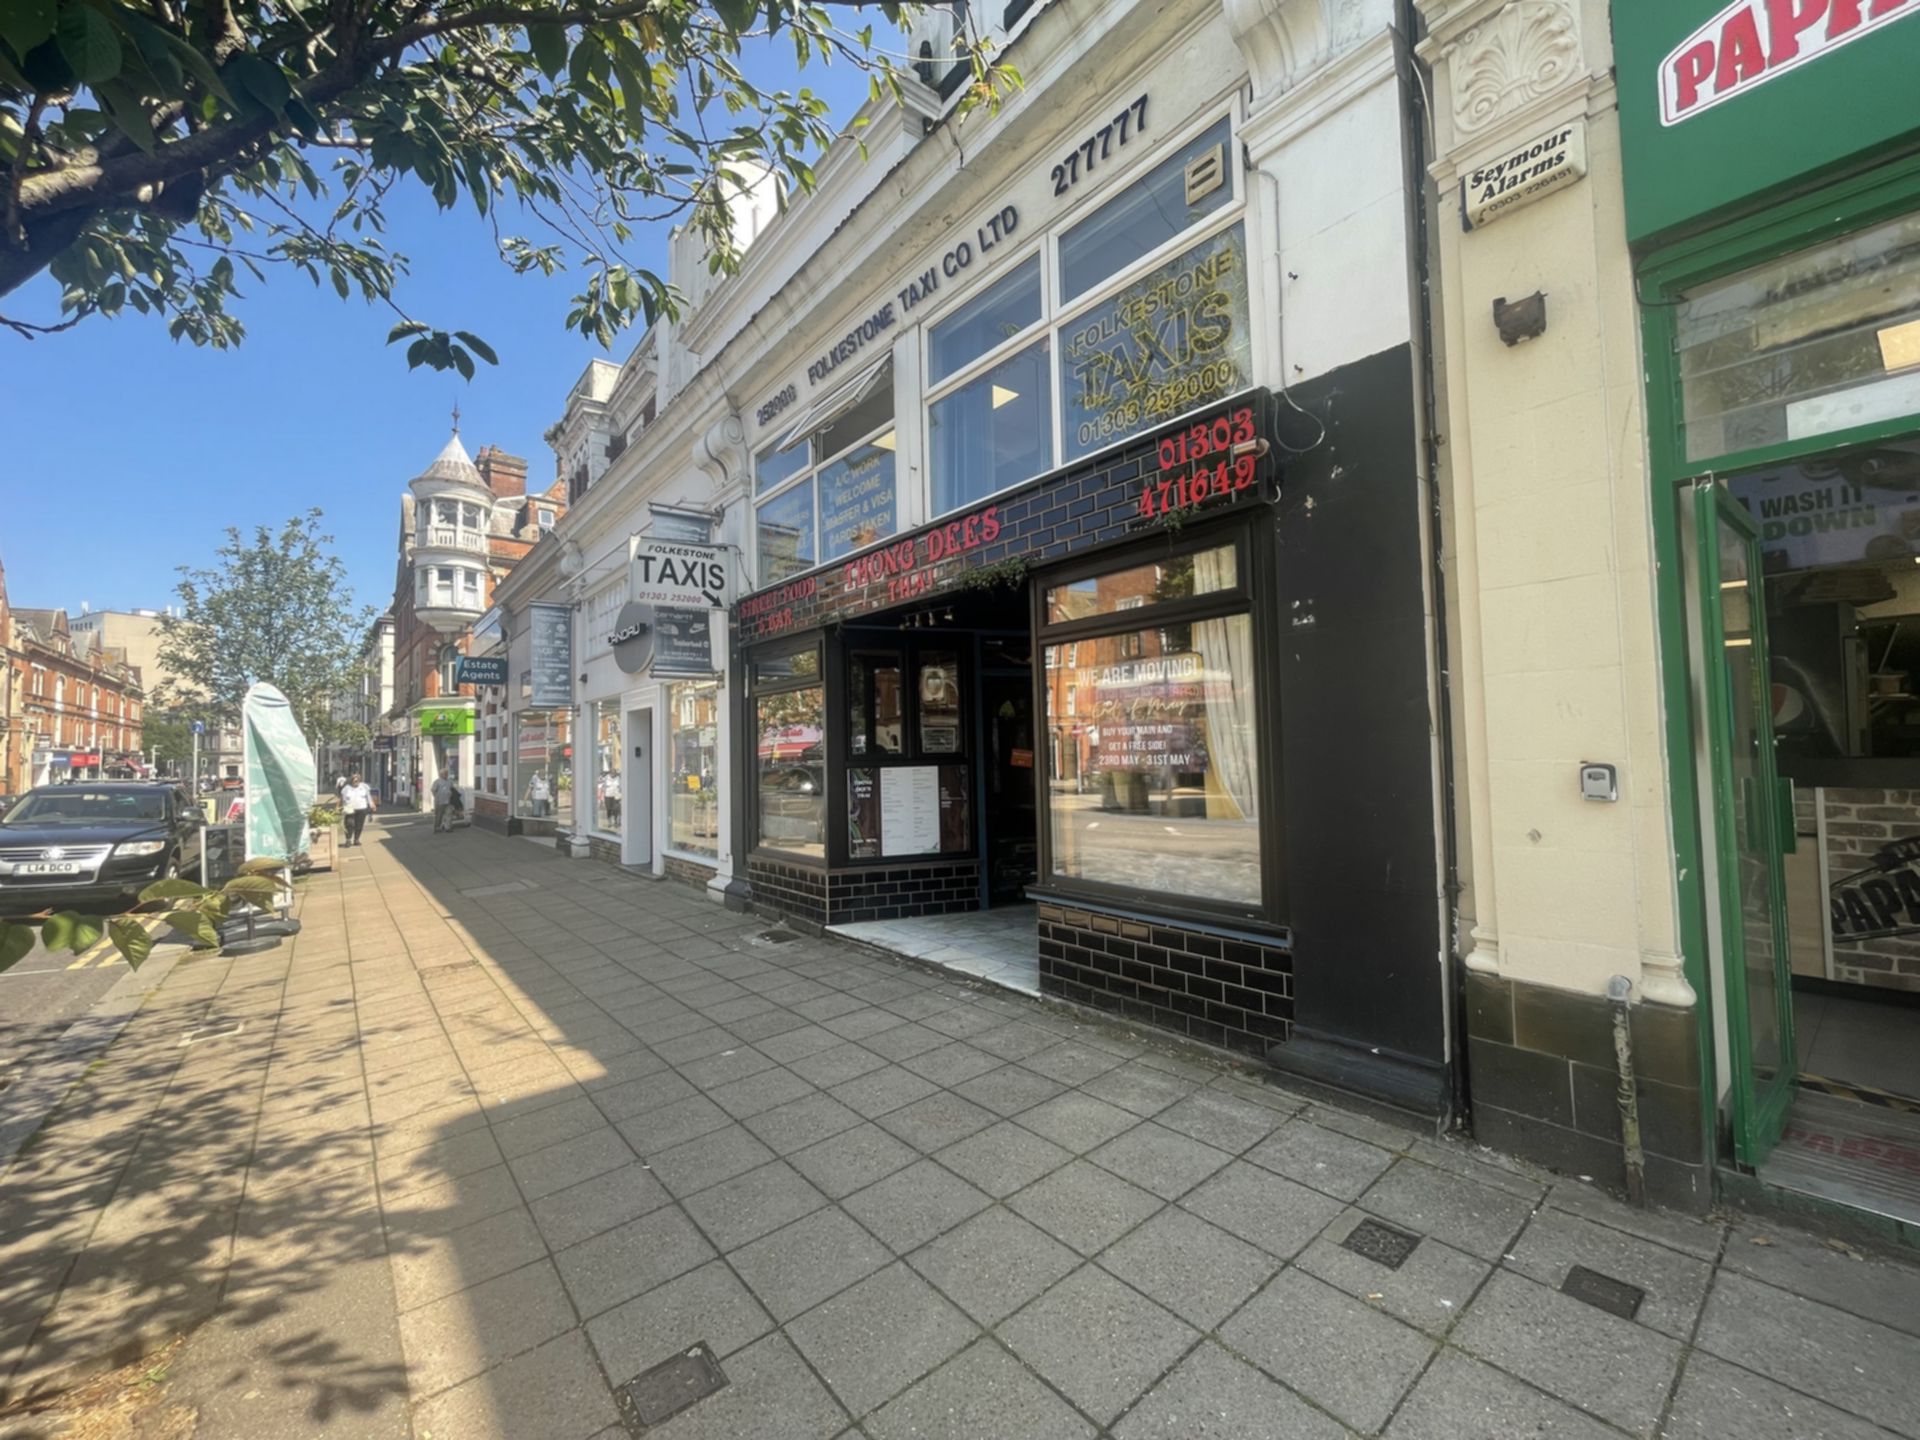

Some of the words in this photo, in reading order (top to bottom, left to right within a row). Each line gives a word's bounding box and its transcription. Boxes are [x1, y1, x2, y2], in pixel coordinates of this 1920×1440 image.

[1674, 0, 1912, 113] PAP
[1470, 128, 1572, 190] Seymour
[1478, 150, 1566, 205] Alarms
[1489, 193, 1523, 212] 0303
[1525, 167, 1573, 195] 226451
[807, 302, 897, 386] FOLKESTONE
[896, 266, 941, 312] TAXI
[943, 241, 974, 279] CO
[977, 204, 1019, 250] LTD
[1050, 93, 1150, 198] 277777
[1071, 247, 1233, 357] FOLKESTONE
[1073, 290, 1232, 408] TAXIS
[1078, 400, 1140, 447] 01303
[1144, 360, 1233, 417] 252000
[1158, 408, 1256, 471] 01303
[835, 473, 881, 507] WELCOME
[1137, 454, 1257, 519] 471649
[1760, 487, 1833, 519] WASH
[1840, 484, 1863, 505] IT
[1763, 504, 1877, 541] DOWN
[648, 544, 716, 561] FOLKESTONE
[843, 538, 915, 590] THONG
[927, 504, 1001, 564] DEES
[637, 554, 725, 591] TAXIS
[783, 576, 817, 604] FOOD
[887, 569, 937, 602] THAI
[639, 591, 668, 601] 01303
[670, 593, 703, 604] 252000
[767, 607, 793, 632] BAR
[461, 670, 500, 680] Agents
[463, 660, 498, 670] Estate
[1078, 669, 1099, 688] WE
[1101, 665, 1130, 684] ARE
[1134, 657, 1198, 682] MOVING!
[1103, 726, 1116, 737] BUY
[1157, 724, 1173, 735] AND
[1109, 741, 1121, 751] GET
[1122, 741, 1127, 750] A
[1128, 740, 1146, 751] FREE
[1099, 755, 1119, 766] 23RD
[1121, 755, 1139, 765] MAY
[1146, 754, 1167, 765] 31ST
[1169, 754, 1190, 765] MAY
